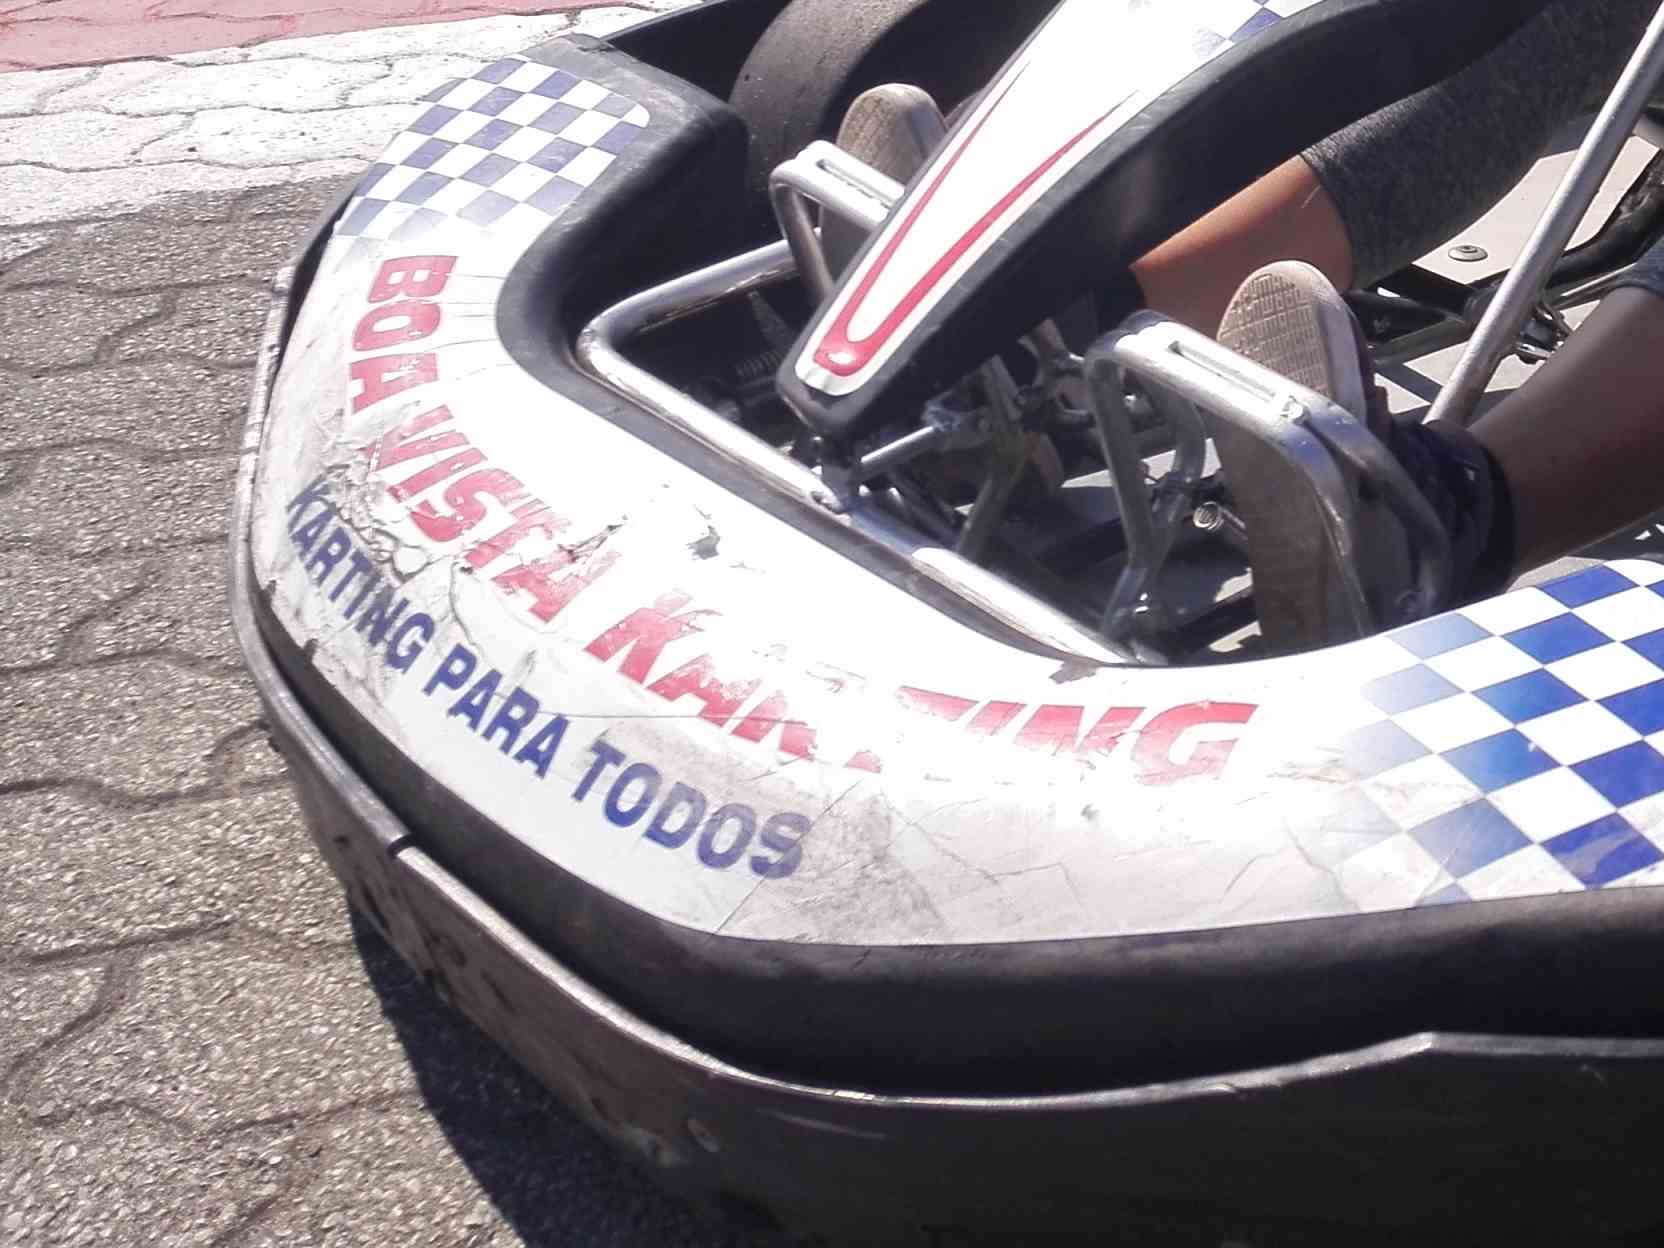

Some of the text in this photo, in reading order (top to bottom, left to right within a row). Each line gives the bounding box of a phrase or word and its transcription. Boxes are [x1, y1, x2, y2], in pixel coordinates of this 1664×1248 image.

[350, 255, 459, 414] BOA
[360, 405, 622, 623] VISTA
[285, 479, 814, 882] KARTING PARA TODOS
